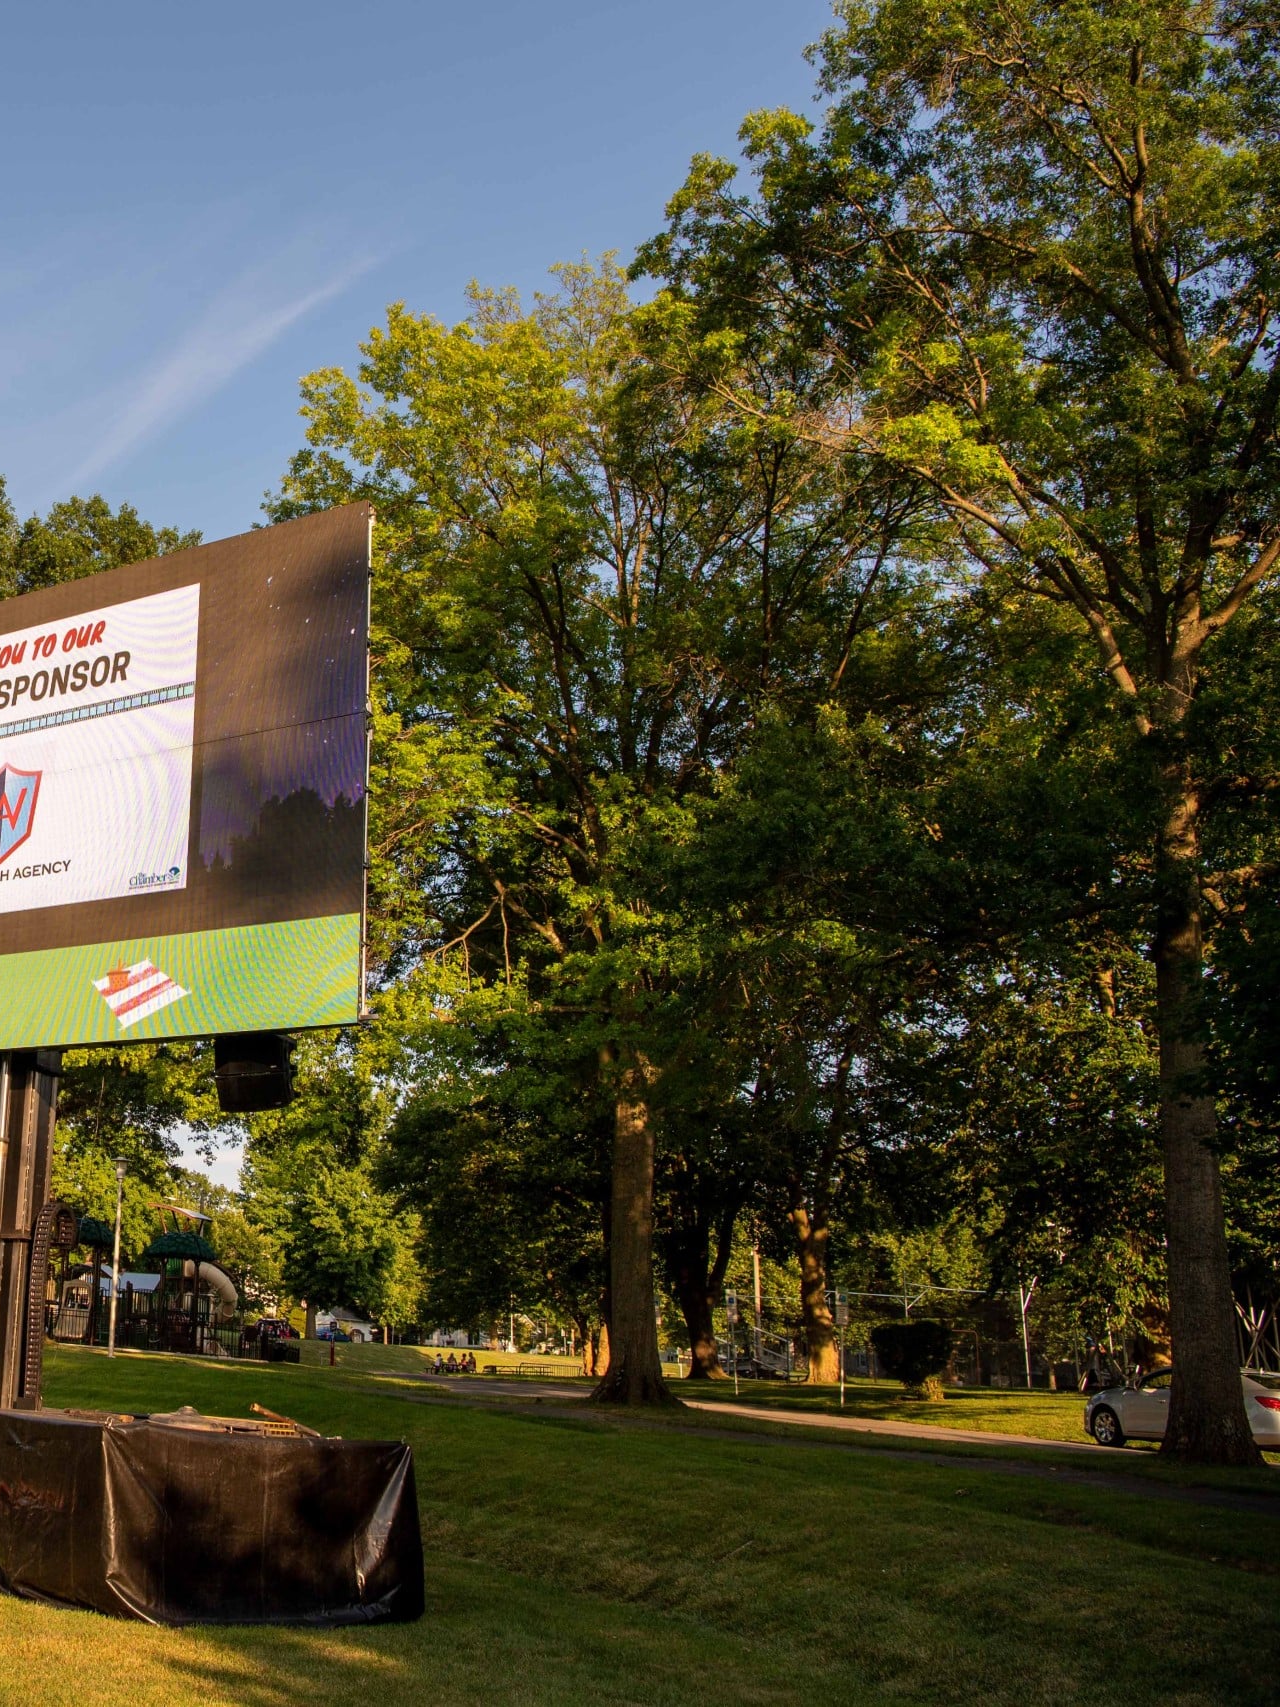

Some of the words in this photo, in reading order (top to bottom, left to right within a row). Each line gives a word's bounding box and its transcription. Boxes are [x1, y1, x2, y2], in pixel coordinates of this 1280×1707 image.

[32, 633, 57, 660] TO
[62, 620, 106, 652] OUR
[13, 859, 71, 880] AGENCY
